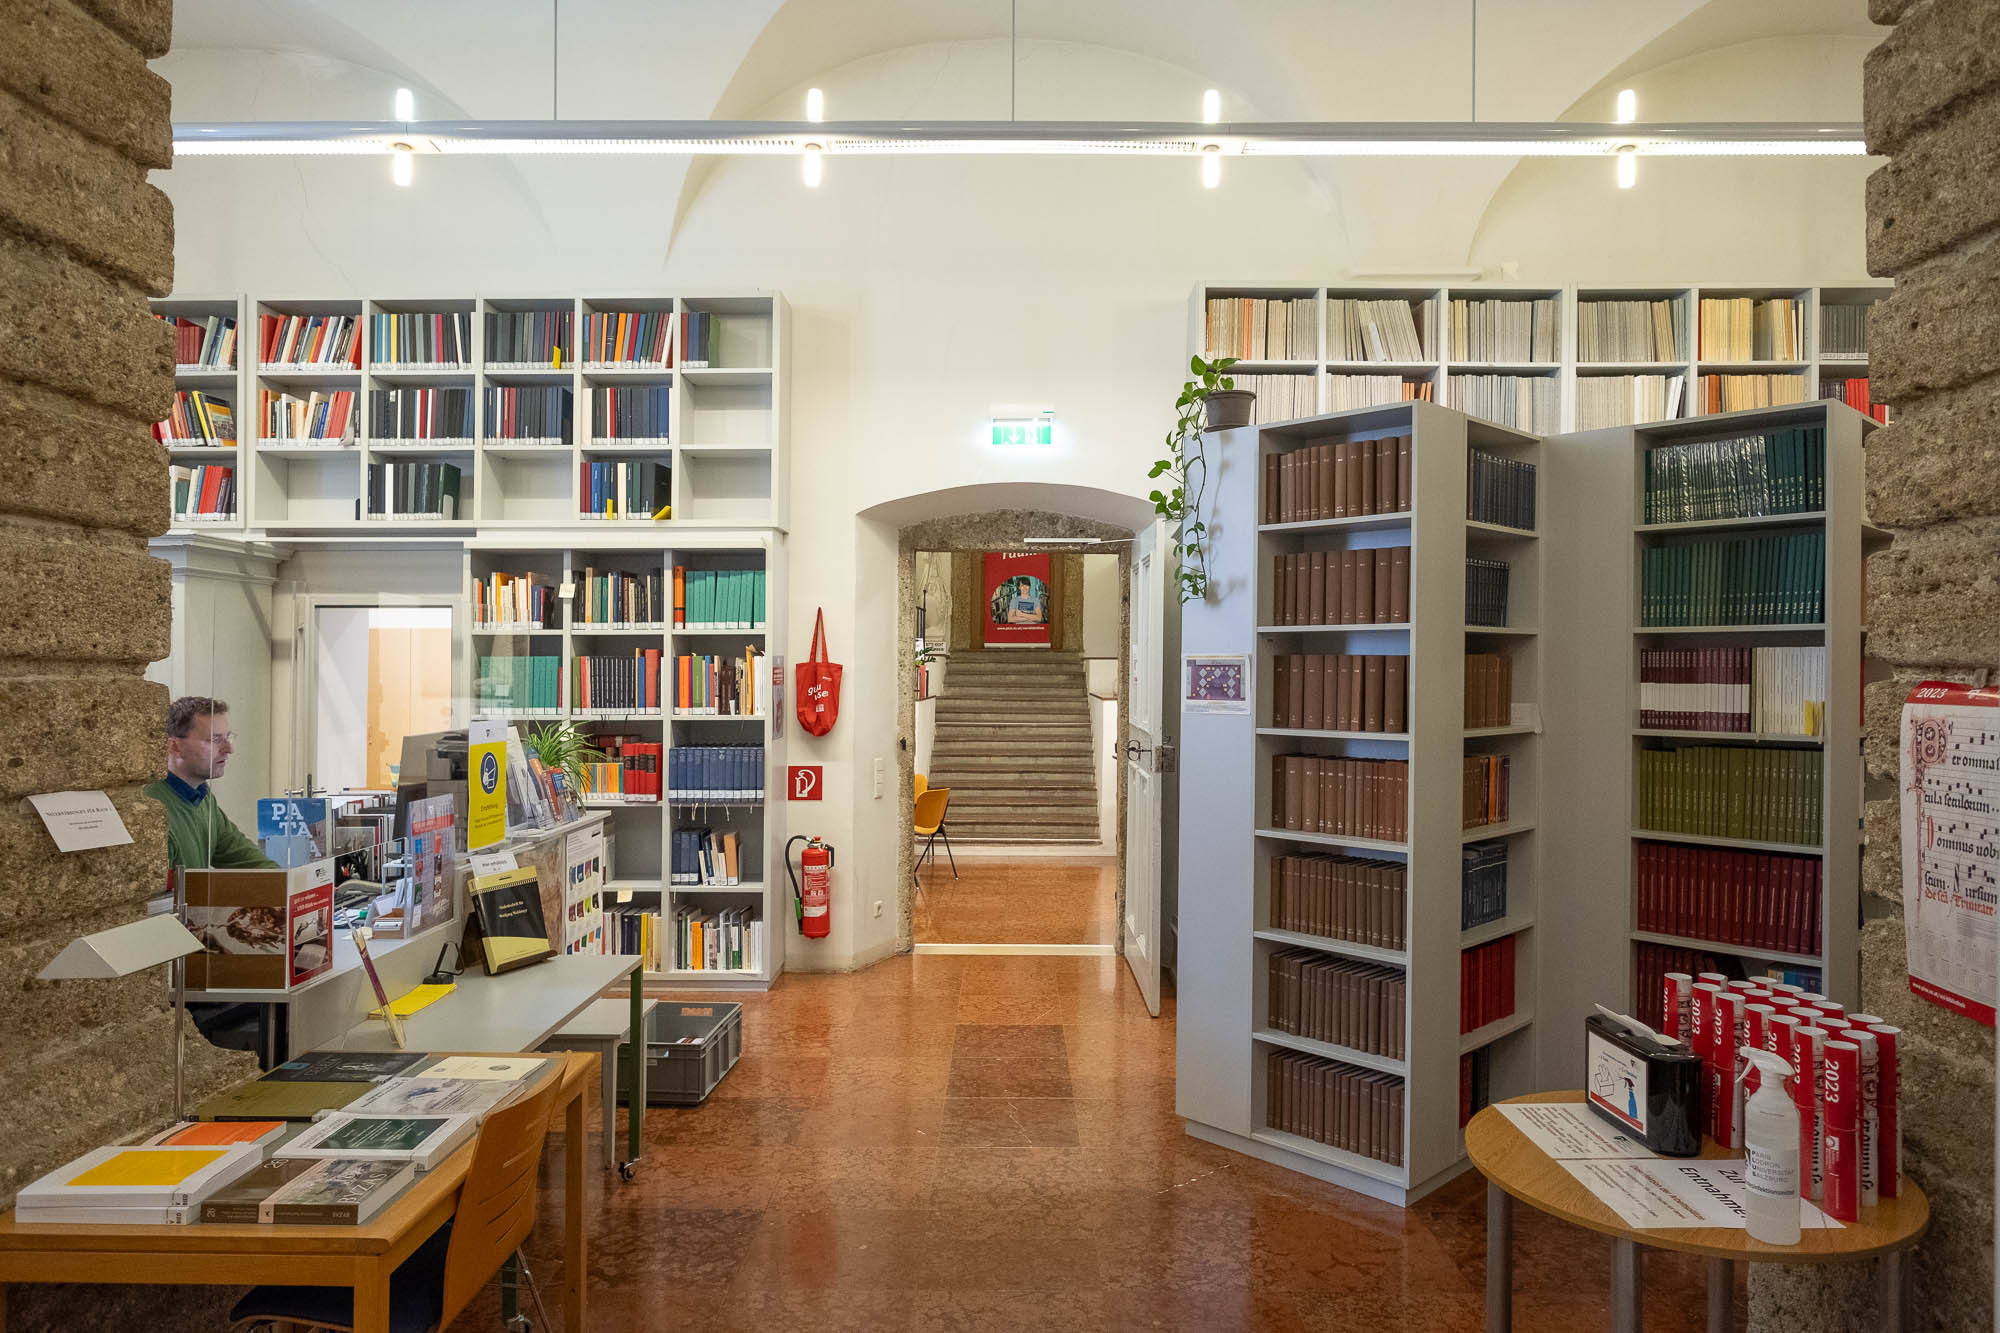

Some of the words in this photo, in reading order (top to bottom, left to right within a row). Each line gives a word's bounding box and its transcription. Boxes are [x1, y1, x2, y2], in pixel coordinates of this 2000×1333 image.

[1916, 687, 1949, 699] 2023
[271, 802, 304, 821] PA
[278, 821, 313, 839] TA
[1691, 997, 1701, 1035] 2023
[1714, 1008, 1723, 1046] 2023
[1743, 1019, 1751, 1048] 202
[1825, 1058, 1840, 1104] 2023
[337, 1172, 388, 1204] BYZAS
[206, 1207, 217, 1218] 26
